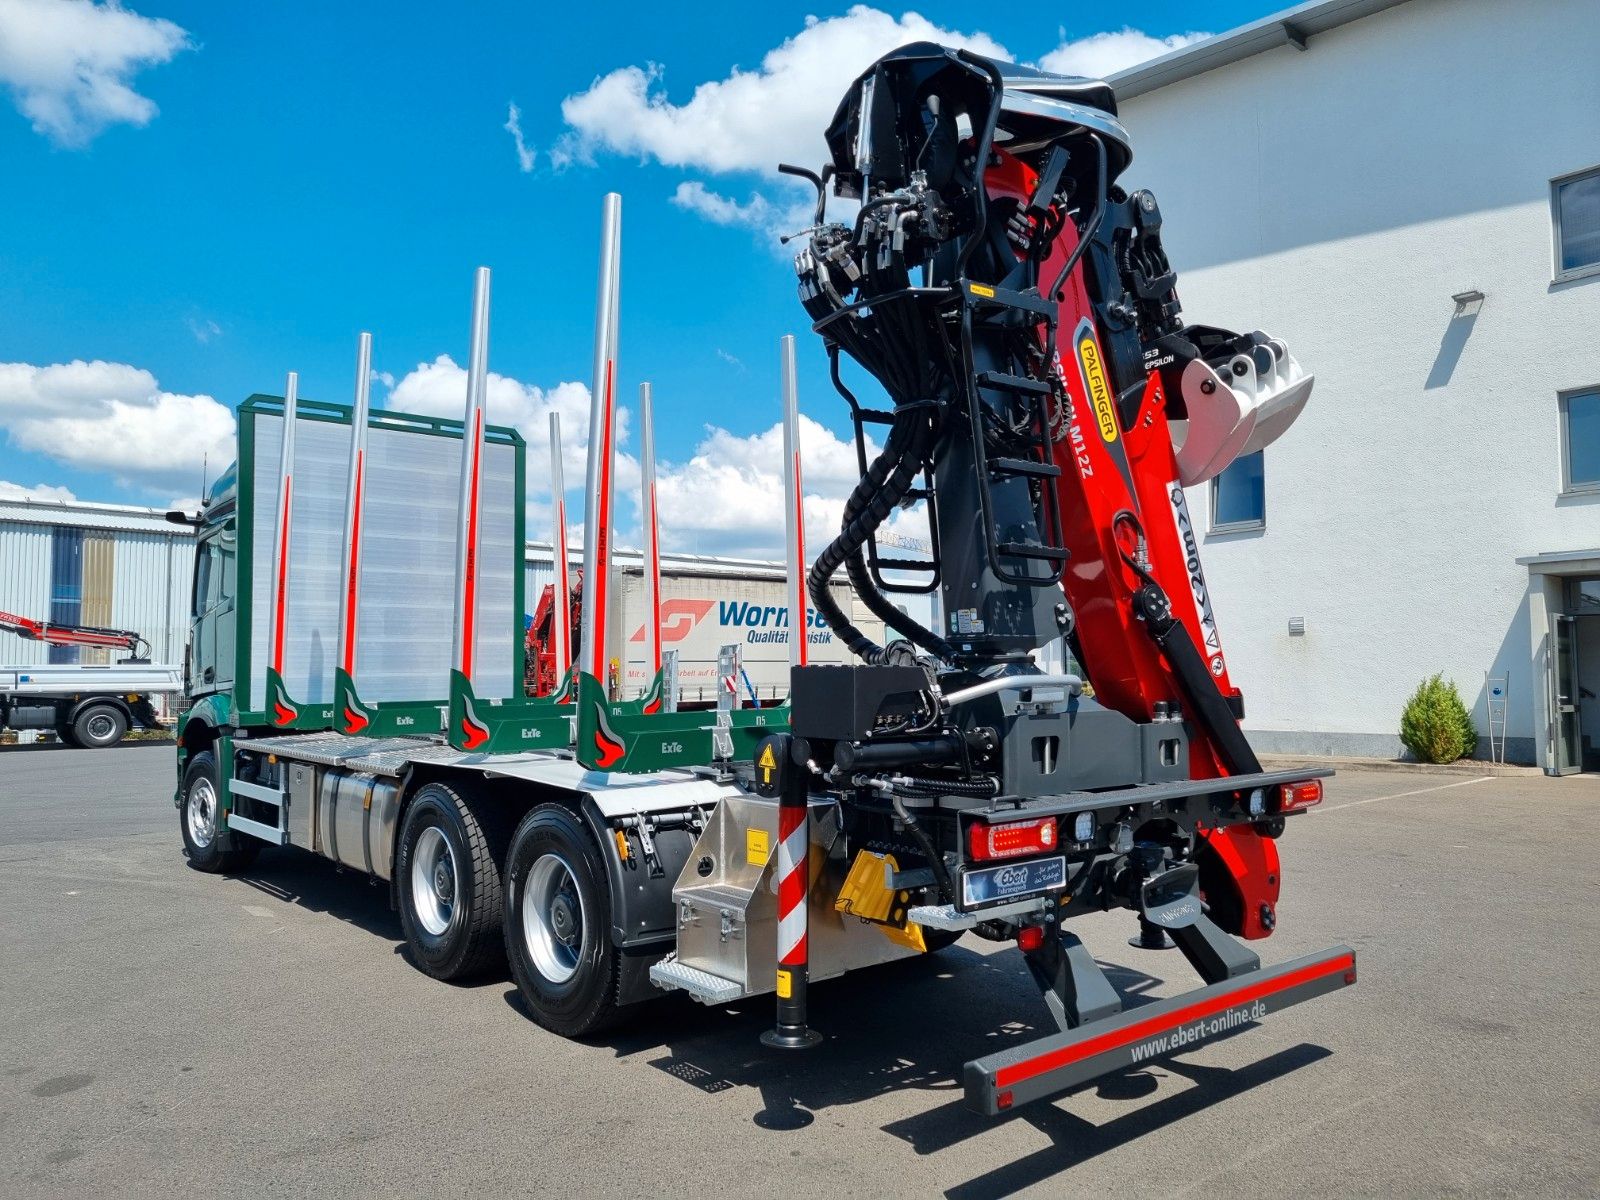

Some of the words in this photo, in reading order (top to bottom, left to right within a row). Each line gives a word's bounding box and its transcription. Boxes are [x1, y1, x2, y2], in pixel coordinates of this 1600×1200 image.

[1144, 354, 1174, 370] EPSILON
[1083, 346, 1114, 435] PALFINGER
[1069, 425, 1093, 479] M12Z
[628, 670, 640, 678] Mit
[679, 669, 696, 678] rbeit
[396, 717, 414, 725] ExTe
[521, 728, 542, 738] ExTe
[662, 742, 683, 754] ExTe
[1131, 1000, 1266, 1063] www.ebert-online.de
